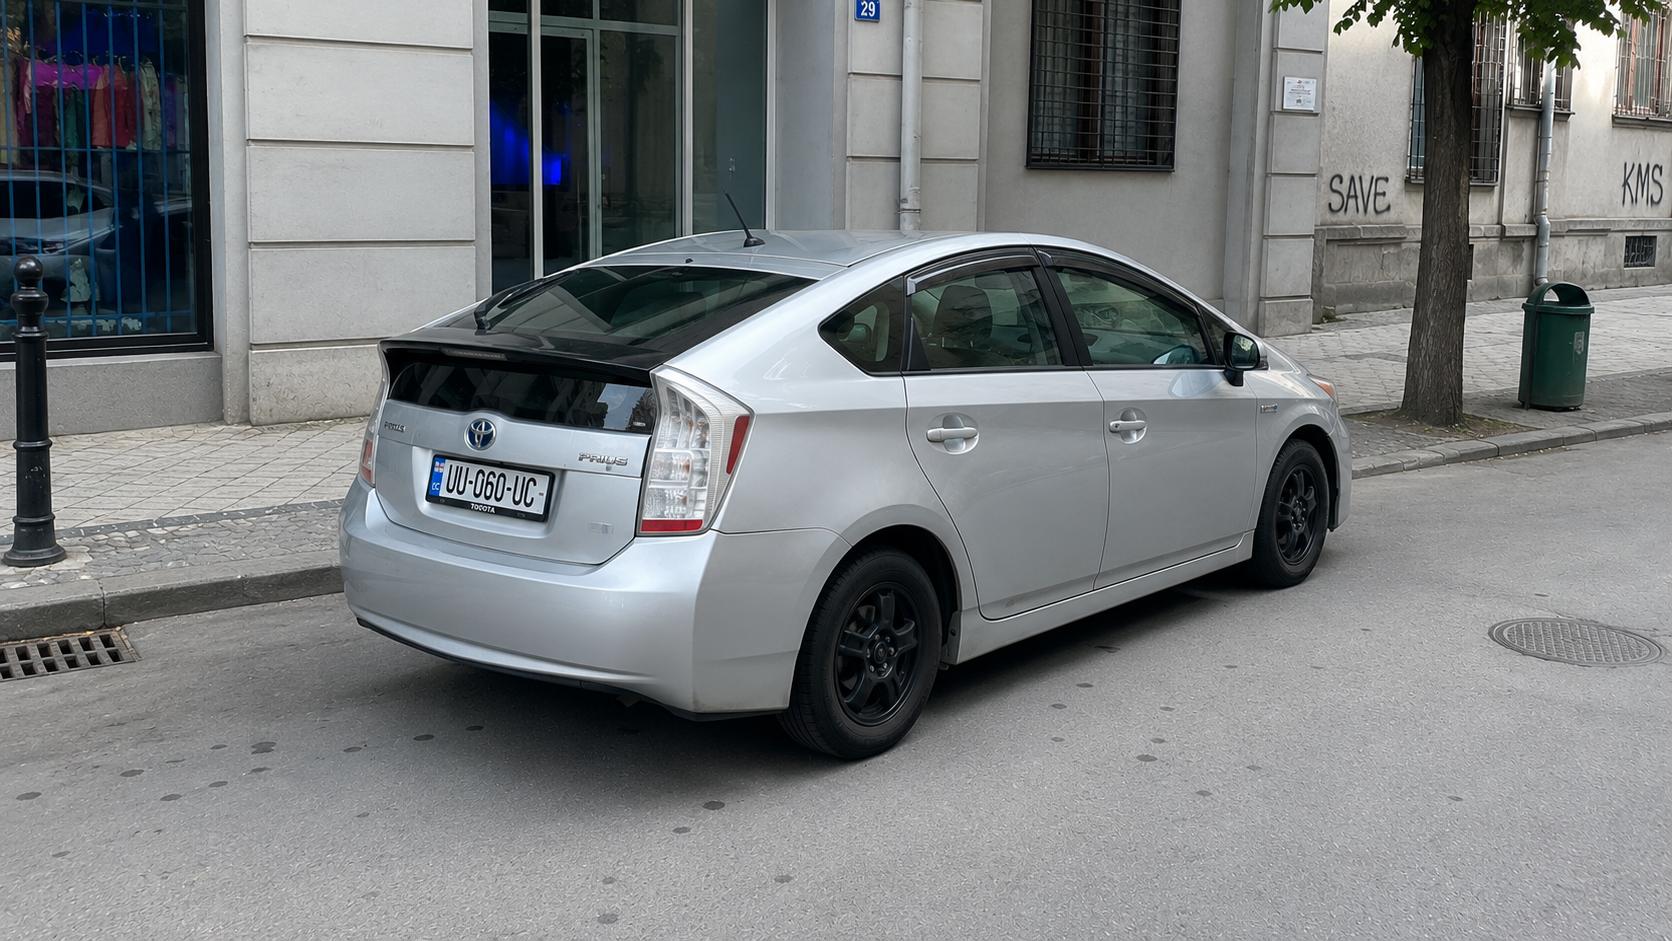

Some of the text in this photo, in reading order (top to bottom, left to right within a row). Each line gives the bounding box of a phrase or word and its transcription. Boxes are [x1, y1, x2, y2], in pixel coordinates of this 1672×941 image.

[860, 1, 876, 17] 29
[1328, 174, 1391, 215] SAVE
[1622, 161, 1664, 207] KMS
[578, 453, 628, 466] PRIUS
[446, 464, 537, 507] UU-060-UC
